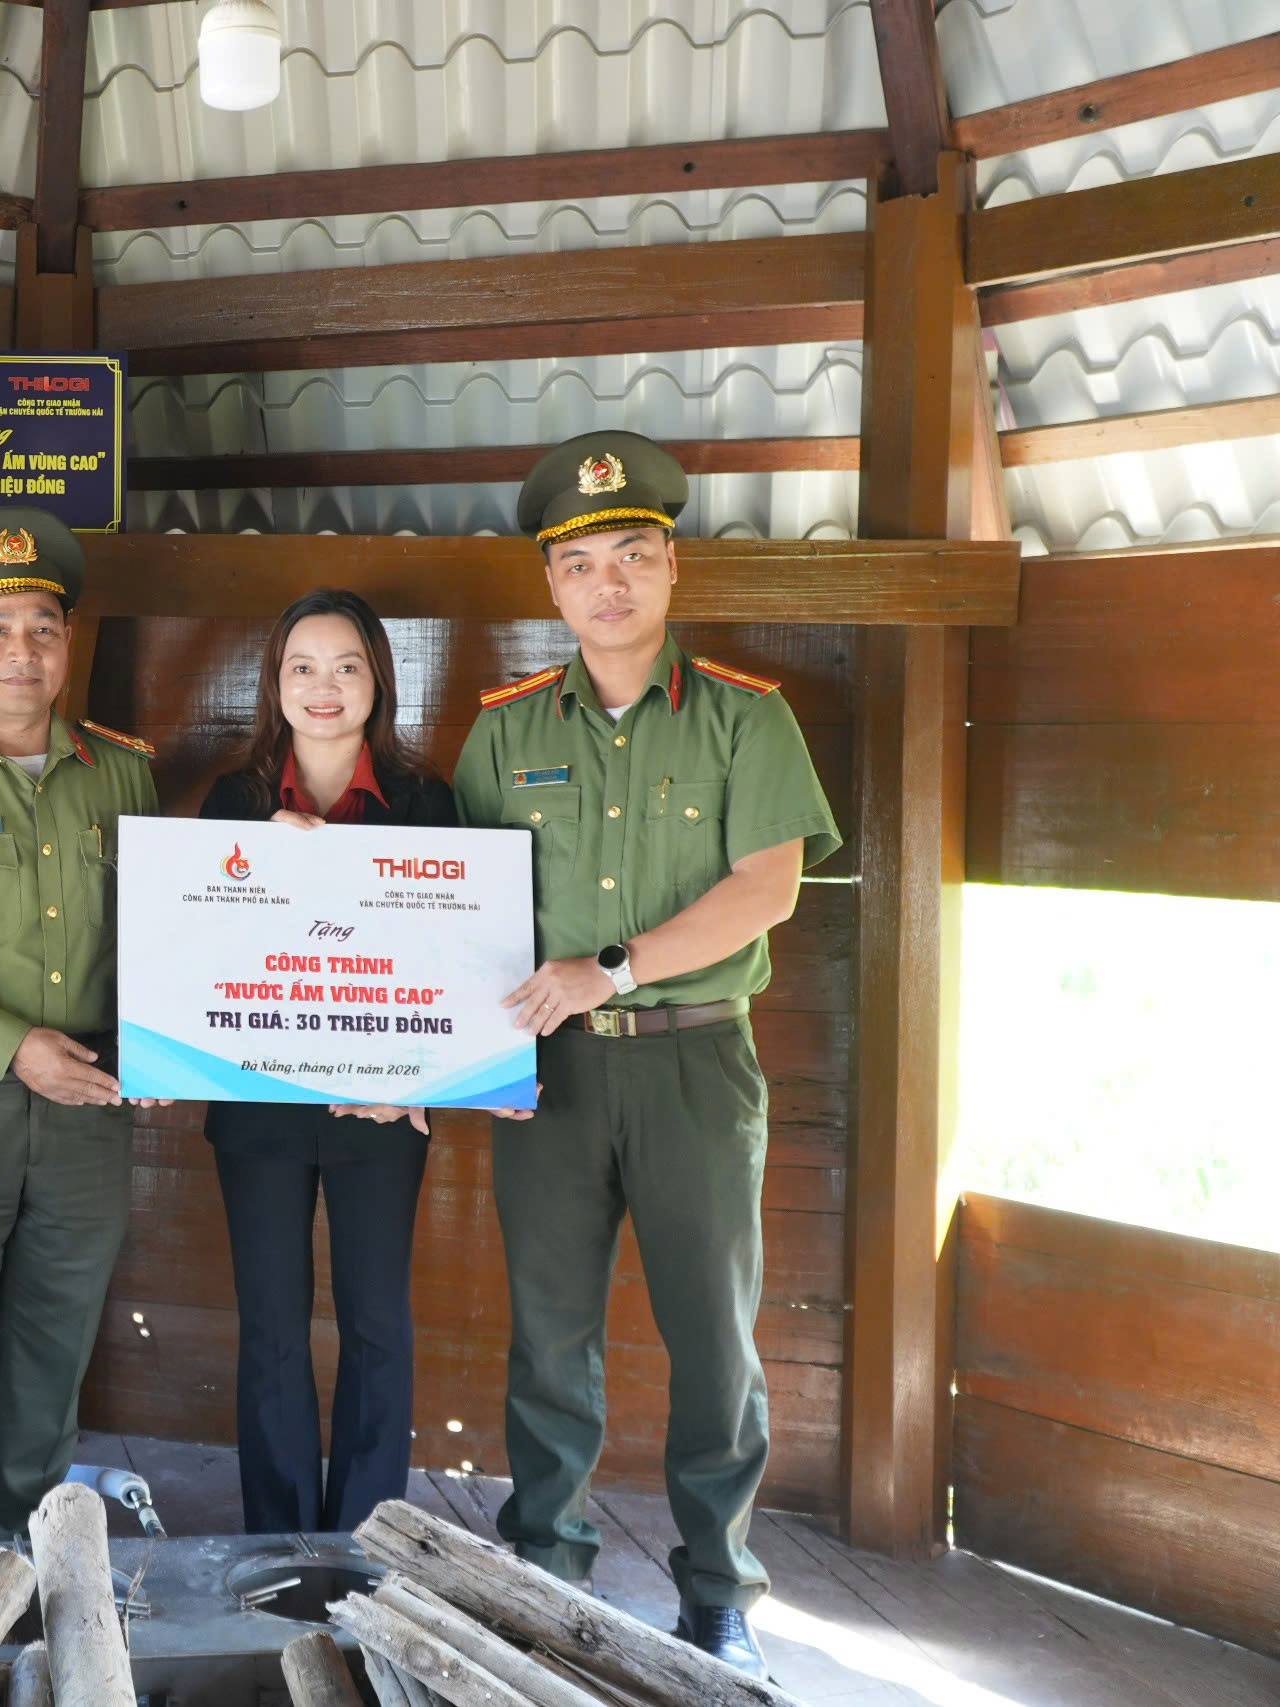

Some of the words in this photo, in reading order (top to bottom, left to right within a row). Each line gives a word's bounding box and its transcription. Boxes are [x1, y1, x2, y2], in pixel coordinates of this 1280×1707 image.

[8, 376, 90, 391] THILOGI
[17, 398, 35, 407] CÔNG
[36, 399, 45, 407] TY
[46, 399, 62, 407] GIAO
[63, 399, 81, 408] NHẬN
[36, 407, 55, 416] QUỐC
[55, 407, 64, 416] TẾ
[2, 449, 26, 470] ẤM
[28, 452, 67, 471] VÙNG
[372, 857, 465, 880] THILOGI
[182, 894, 203, 902] CÔNG
[207, 885, 221, 893] BAN
[224, 886, 247, 894] THANH
[384, 890, 405, 899] CÔNG
[416, 892, 433, 900] GIAO
[307, 919, 356, 942] Tặng
[265, 952, 321, 973] CÔNG
[327, 954, 393, 975] TRÌNH
[289, 978, 325, 1002] ẤM
[330, 983, 389, 1004] VÙNG
[206, 1010, 242, 1032] TRỊ
[248, 1010, 290, 1031] GIÁ:
[296, 1013, 321, 1031] 30
[327, 1012, 390, 1035] TRIỆU
[395, 1011, 453, 1035] ĐỒNG
[240, 1059, 258, 1071] Đà
[260, 1058, 295, 1074] Nẵng,
[298, 1062, 334, 1076] tháng
[337, 1063, 352, 1074] 01
[356, 1063, 384, 1075] năm
[386, 1064, 421, 1076] 2026
